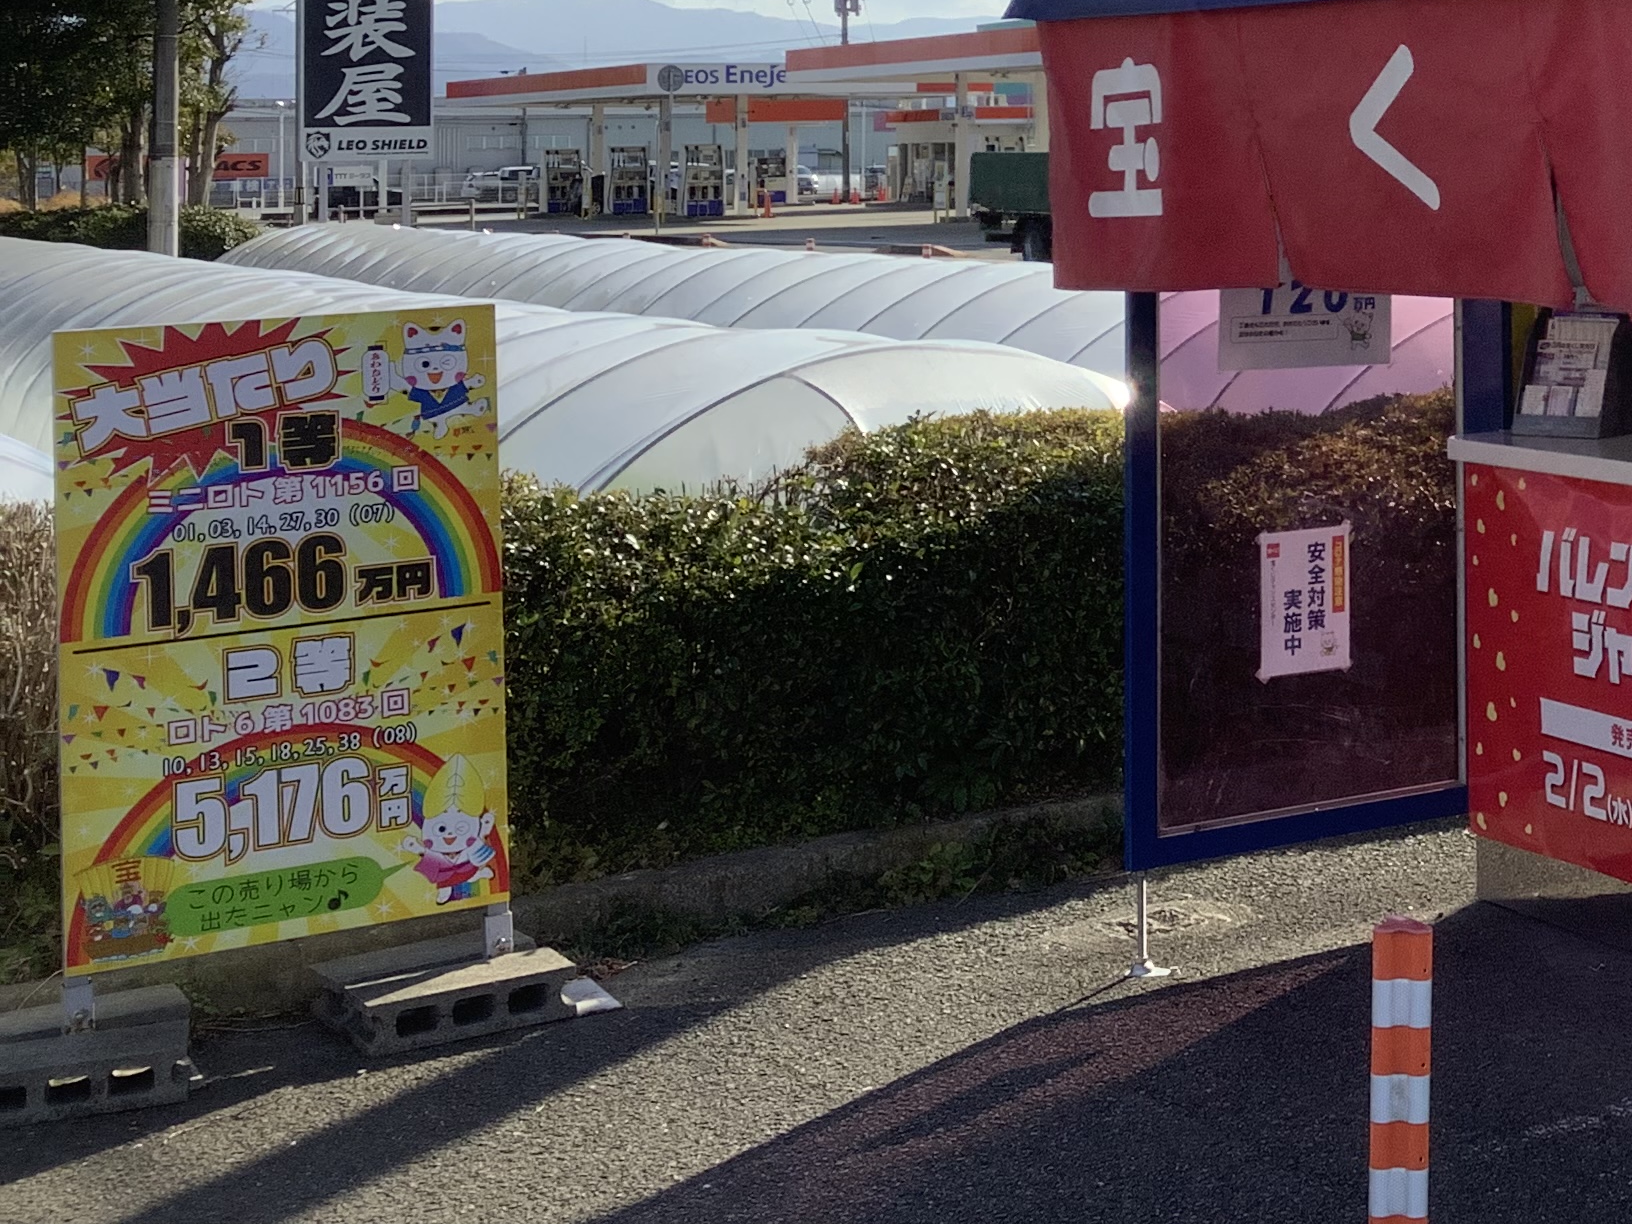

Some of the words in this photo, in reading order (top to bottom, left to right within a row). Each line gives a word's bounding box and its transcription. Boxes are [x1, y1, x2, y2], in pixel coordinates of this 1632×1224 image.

[337, 139, 367, 150] LEO
[371, 138, 428, 150] SHIELD
[74, 339, 338, 452] 大当たり
[228, 412, 341, 468] 1等
[1307, 541, 1326, 631] 安全対策
[1283, 589, 1303, 656] 実施中
[226, 635, 354, 701] 2等
[111, 858, 142, 885] 宝
[187, 863, 359, 909] この売り場から
